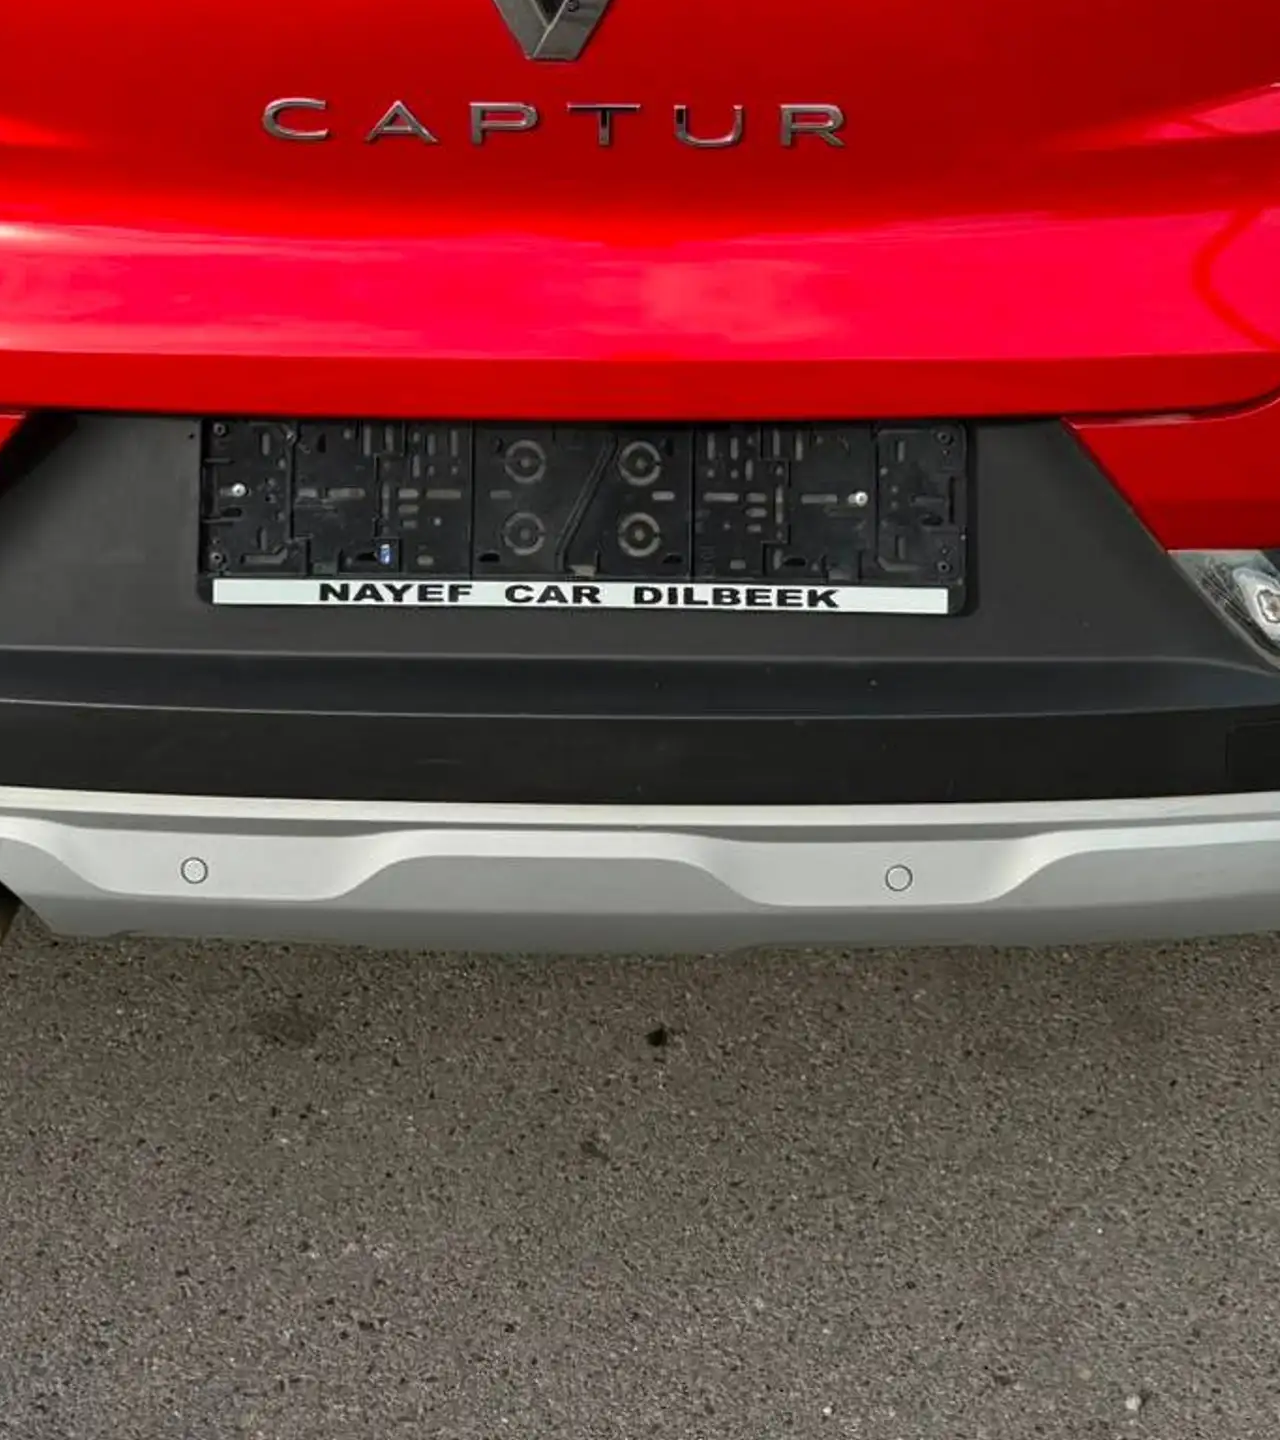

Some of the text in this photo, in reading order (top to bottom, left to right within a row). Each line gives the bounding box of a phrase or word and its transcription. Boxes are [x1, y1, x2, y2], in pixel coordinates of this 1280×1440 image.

[262, 97, 847, 147] CAPTUR
[319, 582, 841, 609] NAYEF CAR DILBEEK
